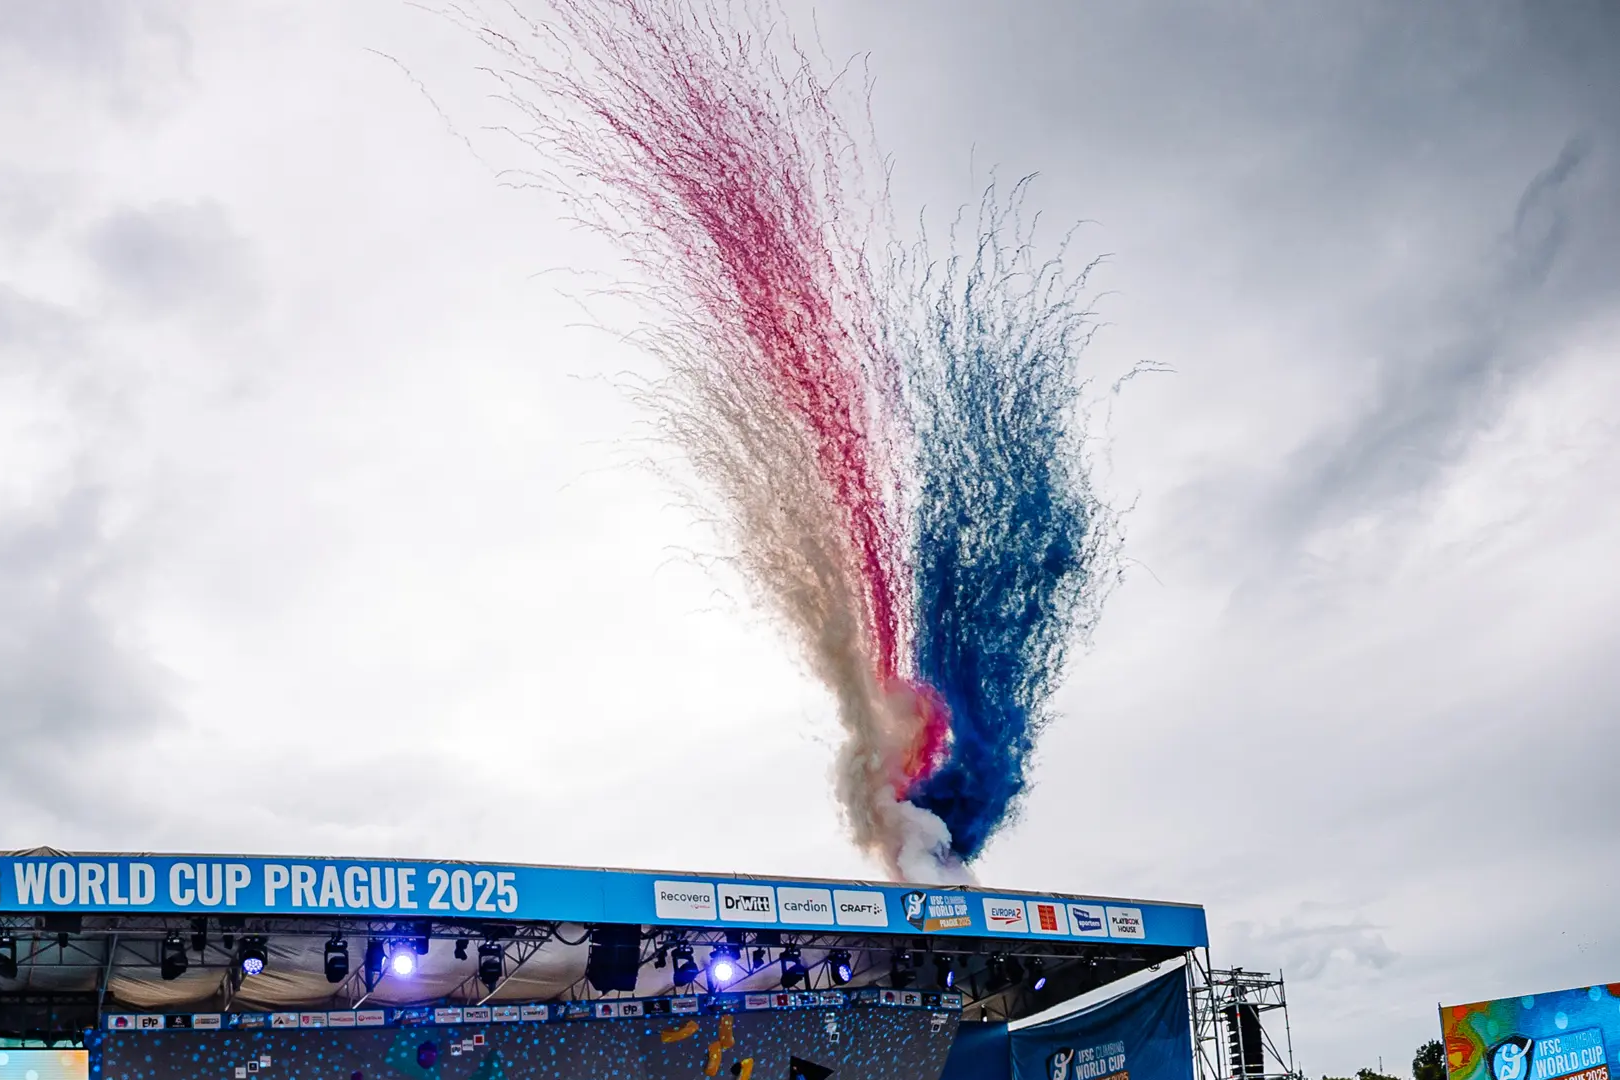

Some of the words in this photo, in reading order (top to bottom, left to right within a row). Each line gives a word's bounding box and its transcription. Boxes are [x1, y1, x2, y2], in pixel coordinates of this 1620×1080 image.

[13, 862, 156, 906] WORLD
[168, 863, 252, 907] CUP
[263, 863, 419, 911] PRAGUE
[427, 868, 519, 914] 2025
[660, 891, 711, 903] Recovera
[725, 895, 770, 912] DrWitt
[929, 896, 943, 905] IFSC
[784, 899, 828, 912] cardion
[840, 904, 872, 913] CRAFT
[929, 905, 954, 917] WORLD
[955, 904, 968, 916] CUP
[1112, 917, 1140, 925] PLAYBOOK
[1117, 925, 1137, 933] HOUSE
[1539, 1038, 1562, 1057] IFSC
[1078, 1048, 1094, 1064] IFSC
[1535, 1051, 1580, 1079] WORLD
[1581, 1045, 1603, 1067] CUP
[1075, 1059, 1106, 1080] WORLD
[1108, 1054, 1126, 1072] CUP
